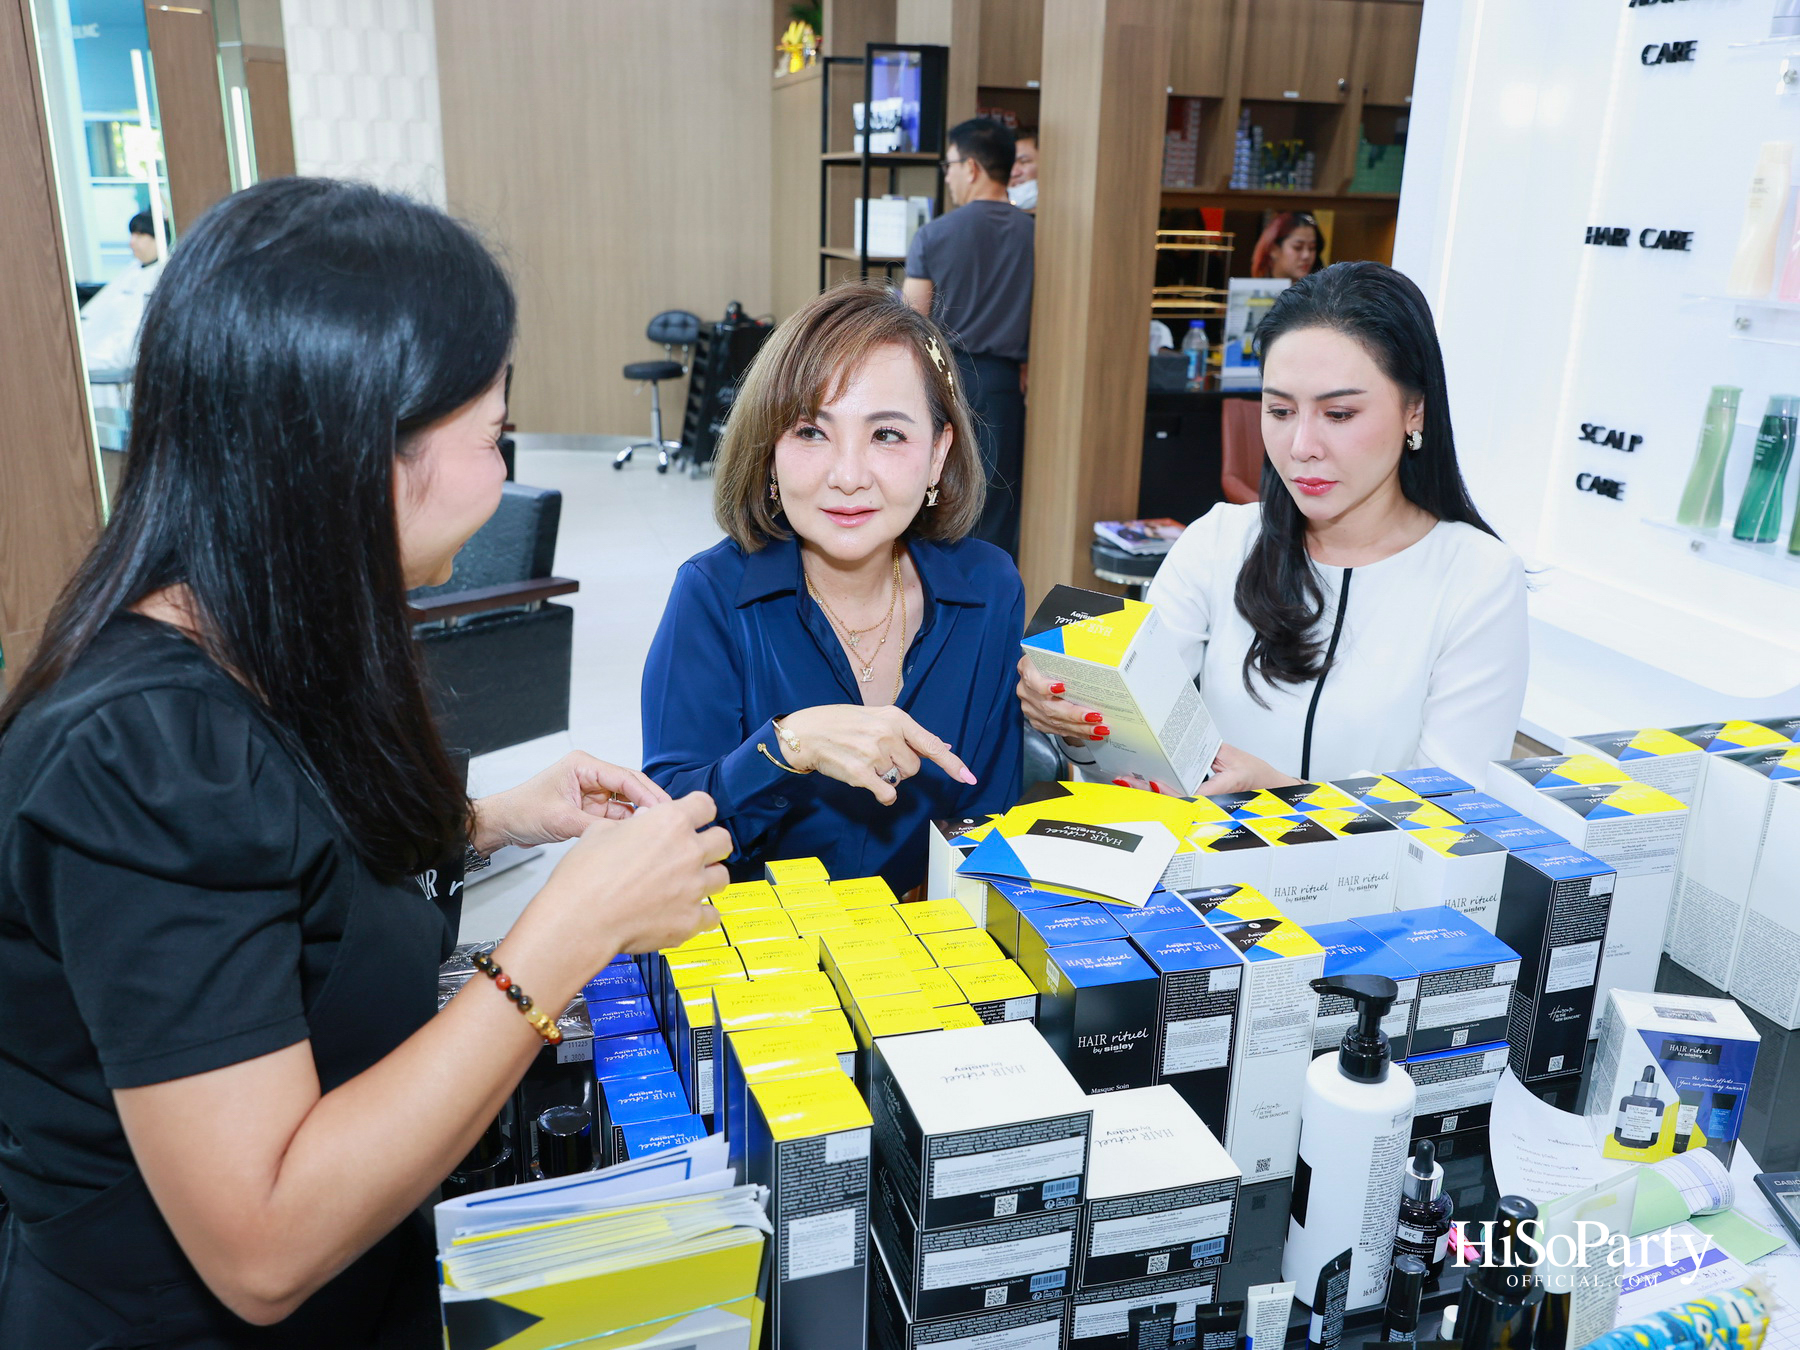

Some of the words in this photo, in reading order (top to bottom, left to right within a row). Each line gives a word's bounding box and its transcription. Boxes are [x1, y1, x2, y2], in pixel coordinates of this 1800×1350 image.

[1641, 40, 1698, 66] CARE
[1585, 226, 1631, 248] HAIR
[1639, 228, 1694, 251] CARE
[1578, 423, 1643, 453] SCALP
[1576, 472, 1626, 502] CARE
[1044, 827, 1087, 843] rituel
[1063, 824, 1097, 835] sisley
[1090, 833, 1123, 846] HAIR
[1337, 875, 1360, 887] HAIR
[1362, 871, 1390, 883] rituel
[1274, 887, 1298, 898] HAIR
[1300, 882, 1330, 895] rituel
[1356, 882, 1380, 891] sisley
[1293, 893, 1318, 902] sisley
[1444, 897, 1467, 910] HAIR
[1469, 893, 1498, 905] rituel
[1463, 905, 1487, 914] sisley
[1065, 957, 1096, 968] HAIR
[1097, 952, 1133, 964] rituel
[1093, 960, 1123, 969] sisley
[1078, 1034, 1108, 1049] HAIR
[1111, 1027, 1150, 1043] rituel
[636, 1048, 660, 1057] HAIR
[1092, 1046, 1104, 1055] by
[1103, 1041, 1134, 1053] sisley
[1669, 1044, 1688, 1053] HAIR
[1689, 1046, 1713, 1055] rituel
[604, 1051, 635, 1061] rituel
[954, 1063, 991, 1072] sisley
[990, 1064, 1027, 1076] HAIR
[940, 1071, 986, 1084] rituel
[628, 1090, 654, 1098] sisley
[1091, 1085, 1115, 1095] Masque
[1116, 1082, 1130, 1091] Soin
[618, 1094, 650, 1105] rituel
[652, 1091, 677, 1100] HAIR
[1106, 1127, 1139, 1137] sisley
[1140, 1128, 1175, 1141] HAIR
[649, 1134, 675, 1142] sisley
[674, 1135, 699, 1145] HAIR
[1094, 1135, 1137, 1148] rituel
[638, 1139, 672, 1150] rituel
[1404, 1231, 1417, 1239] PFC
